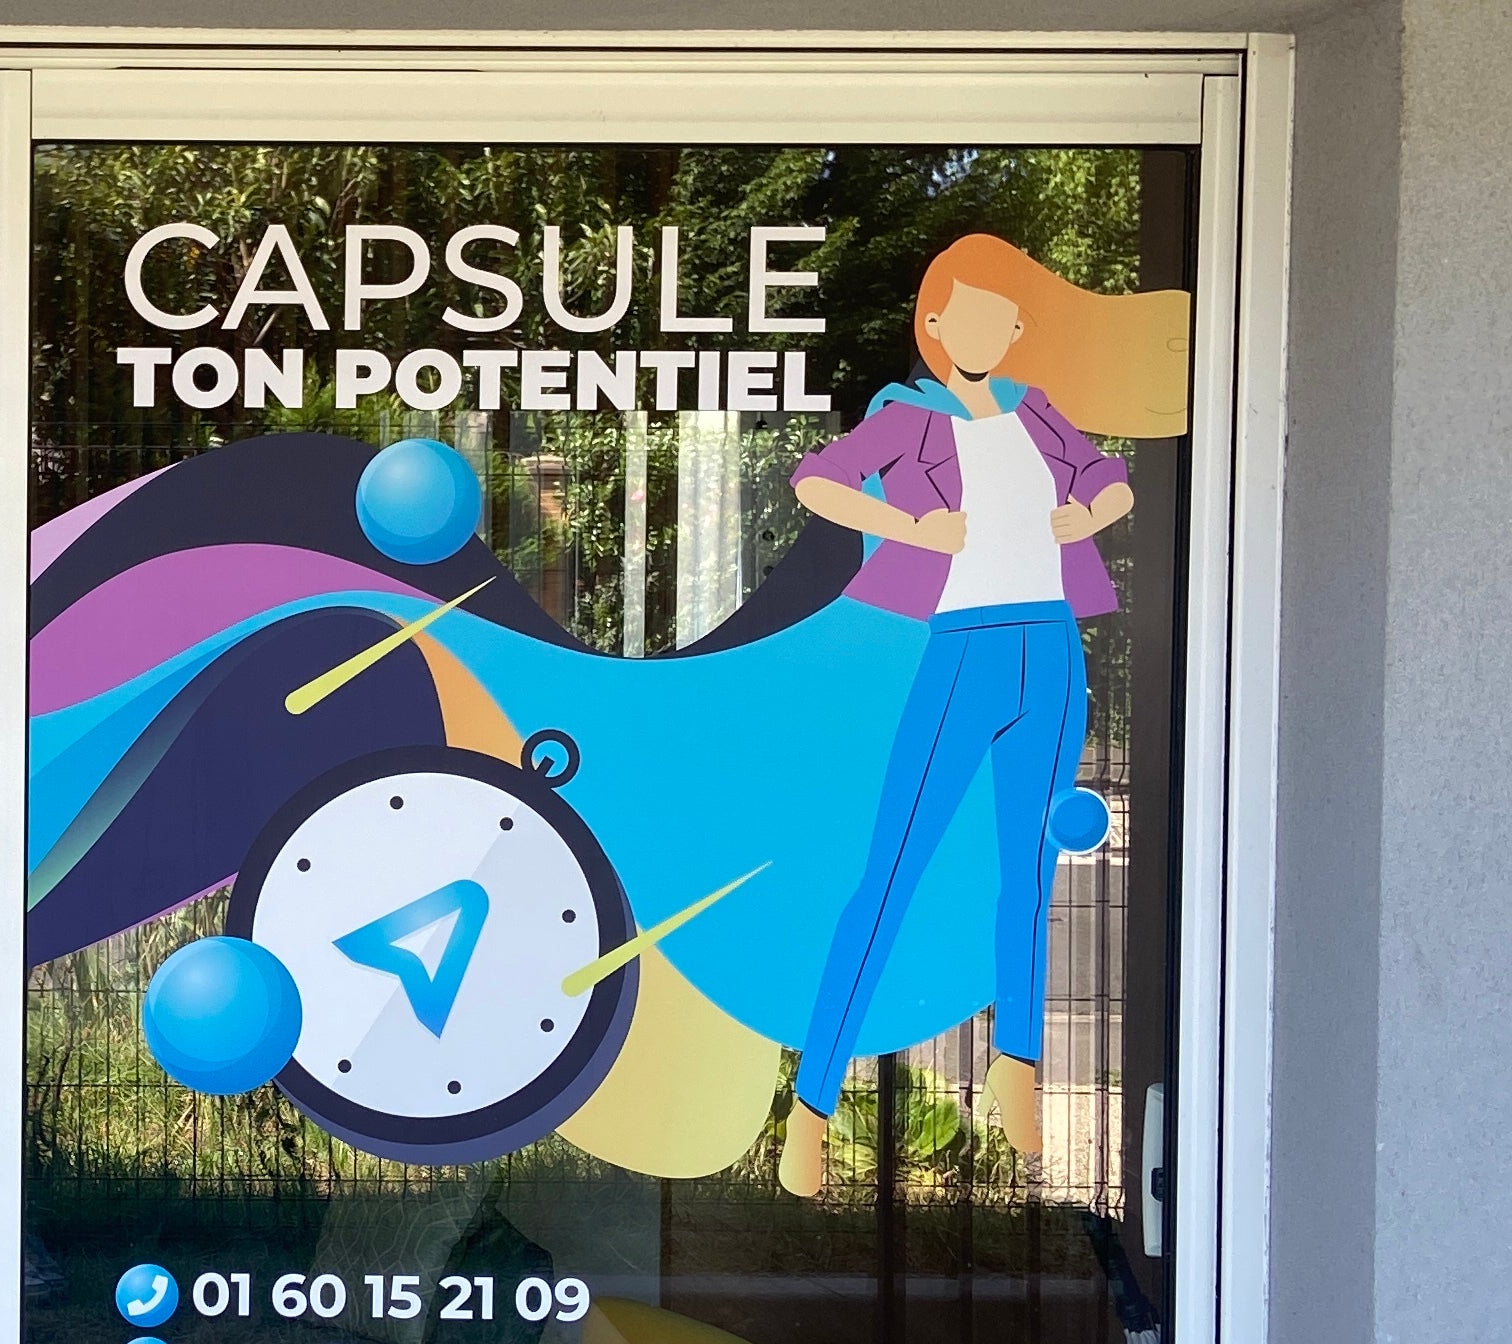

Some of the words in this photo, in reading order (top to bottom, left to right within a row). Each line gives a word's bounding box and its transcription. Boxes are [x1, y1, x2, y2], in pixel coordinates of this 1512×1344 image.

[123, 223, 826, 334] CAPSULE
[116, 346, 304, 409] TON
[334, 346, 832, 412] POTENTIEL
[191, 1271, 252, 1318] 01
[270, 1272, 348, 1319] 60
[363, 1273, 423, 1320] 15
[437, 1274, 495, 1321] 21
[514, 1275, 591, 1323] 09
